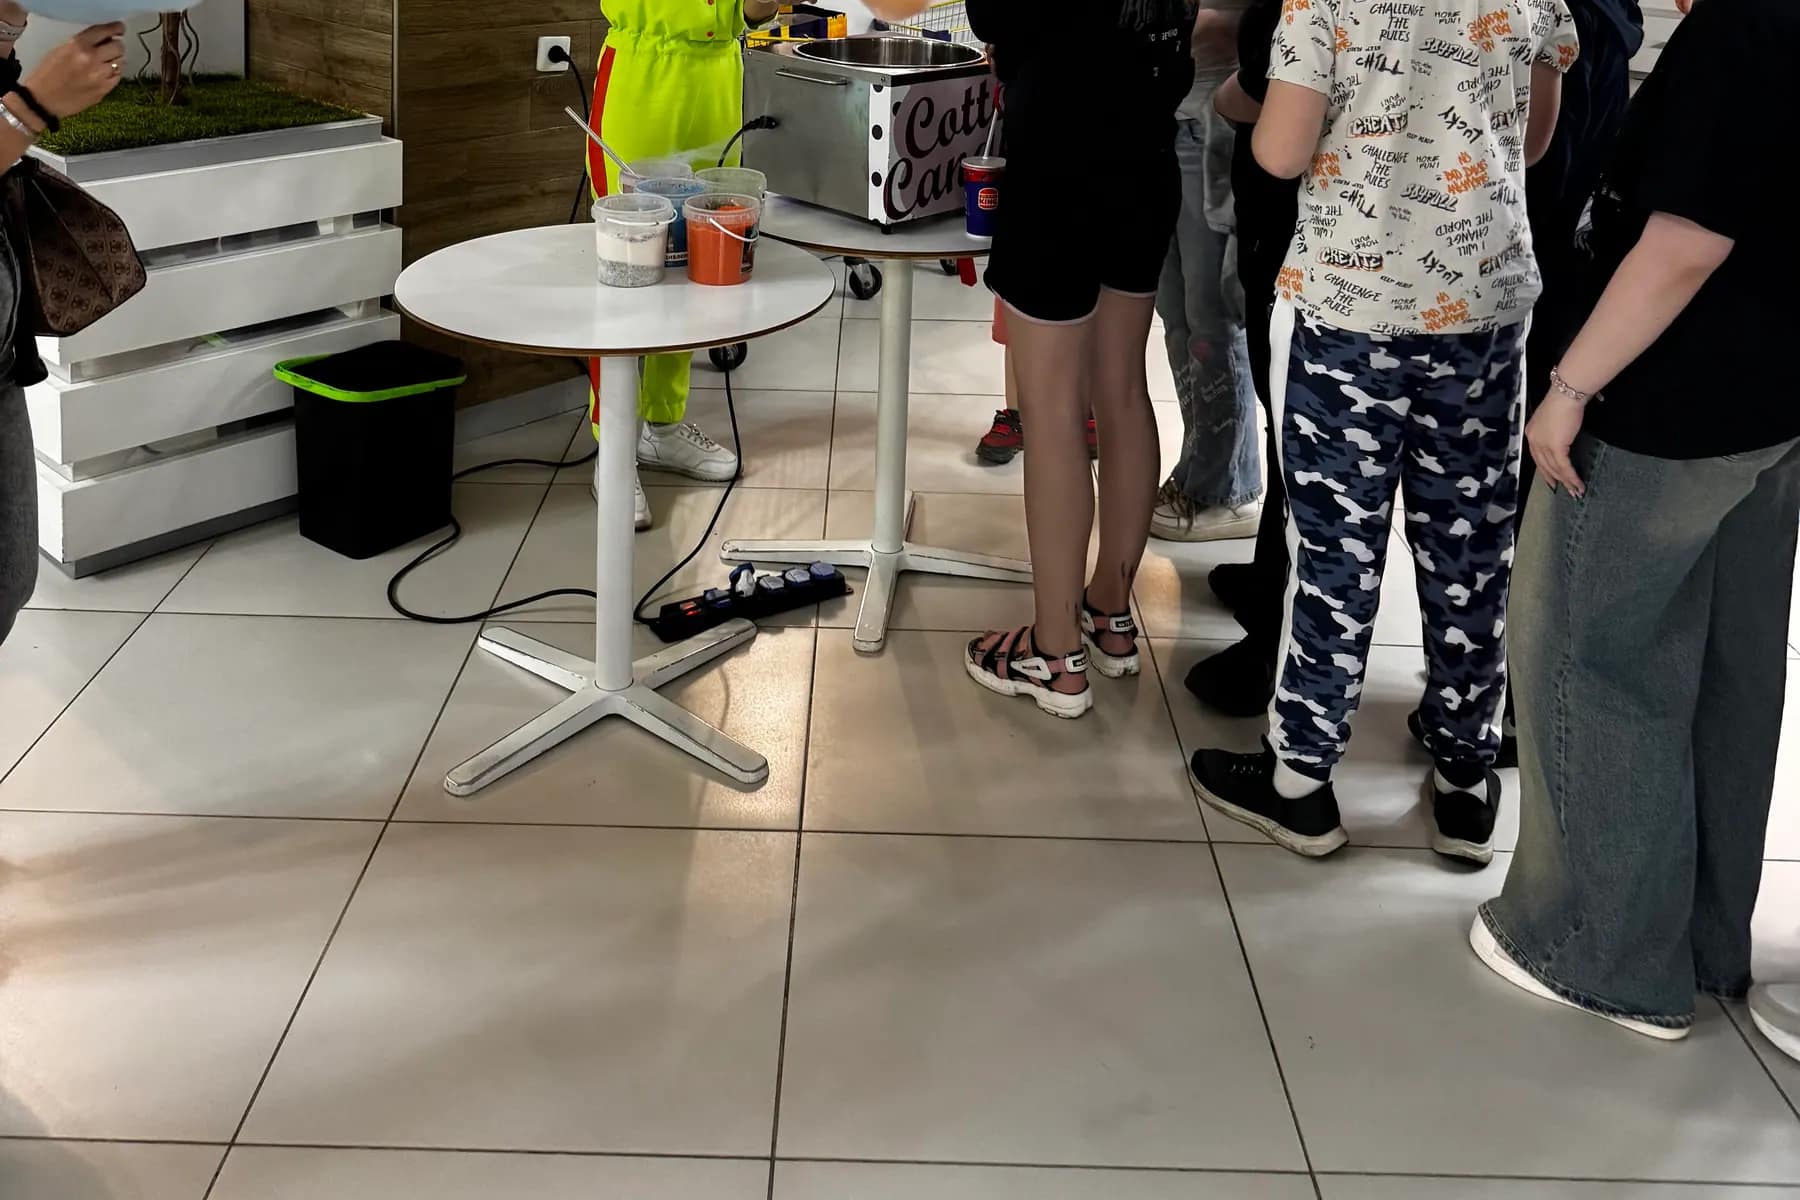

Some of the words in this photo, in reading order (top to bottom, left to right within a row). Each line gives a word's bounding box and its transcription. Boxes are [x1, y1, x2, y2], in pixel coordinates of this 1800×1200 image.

[1370, 3, 1426, 18] CHALLENGE
[1388, 17, 1409, 29] THE
[1379, 29, 1411, 42] RULES
[1355, 52, 1404, 75] CHILL
[1487, 64, 1511, 76] THE
[905, 80, 1005, 159] Cott
[1438, 105, 1484, 144] LUCKY
[1361, 144, 1409, 164] CHALLENGE
[1371, 161, 1392, 176] THE
[1363, 170, 1391, 189] RULES
[1325, 204, 1343, 216] THE
[1340, 189, 1378, 219] CHILL
[1476, 208, 1494, 222] THE
[1435, 218, 1472, 236] WORLD
[1446, 226, 1489, 247] CHANGE
[1316, 246, 1384, 272] CREATE
[1457, 243, 1478, 256] WILL
[1417, 250, 1464, 285] LUCKY
[1324, 273, 1383, 302] CHALLENGE
[1322, 296, 1355, 317] RULES
[1333, 289, 1357, 306] THE
